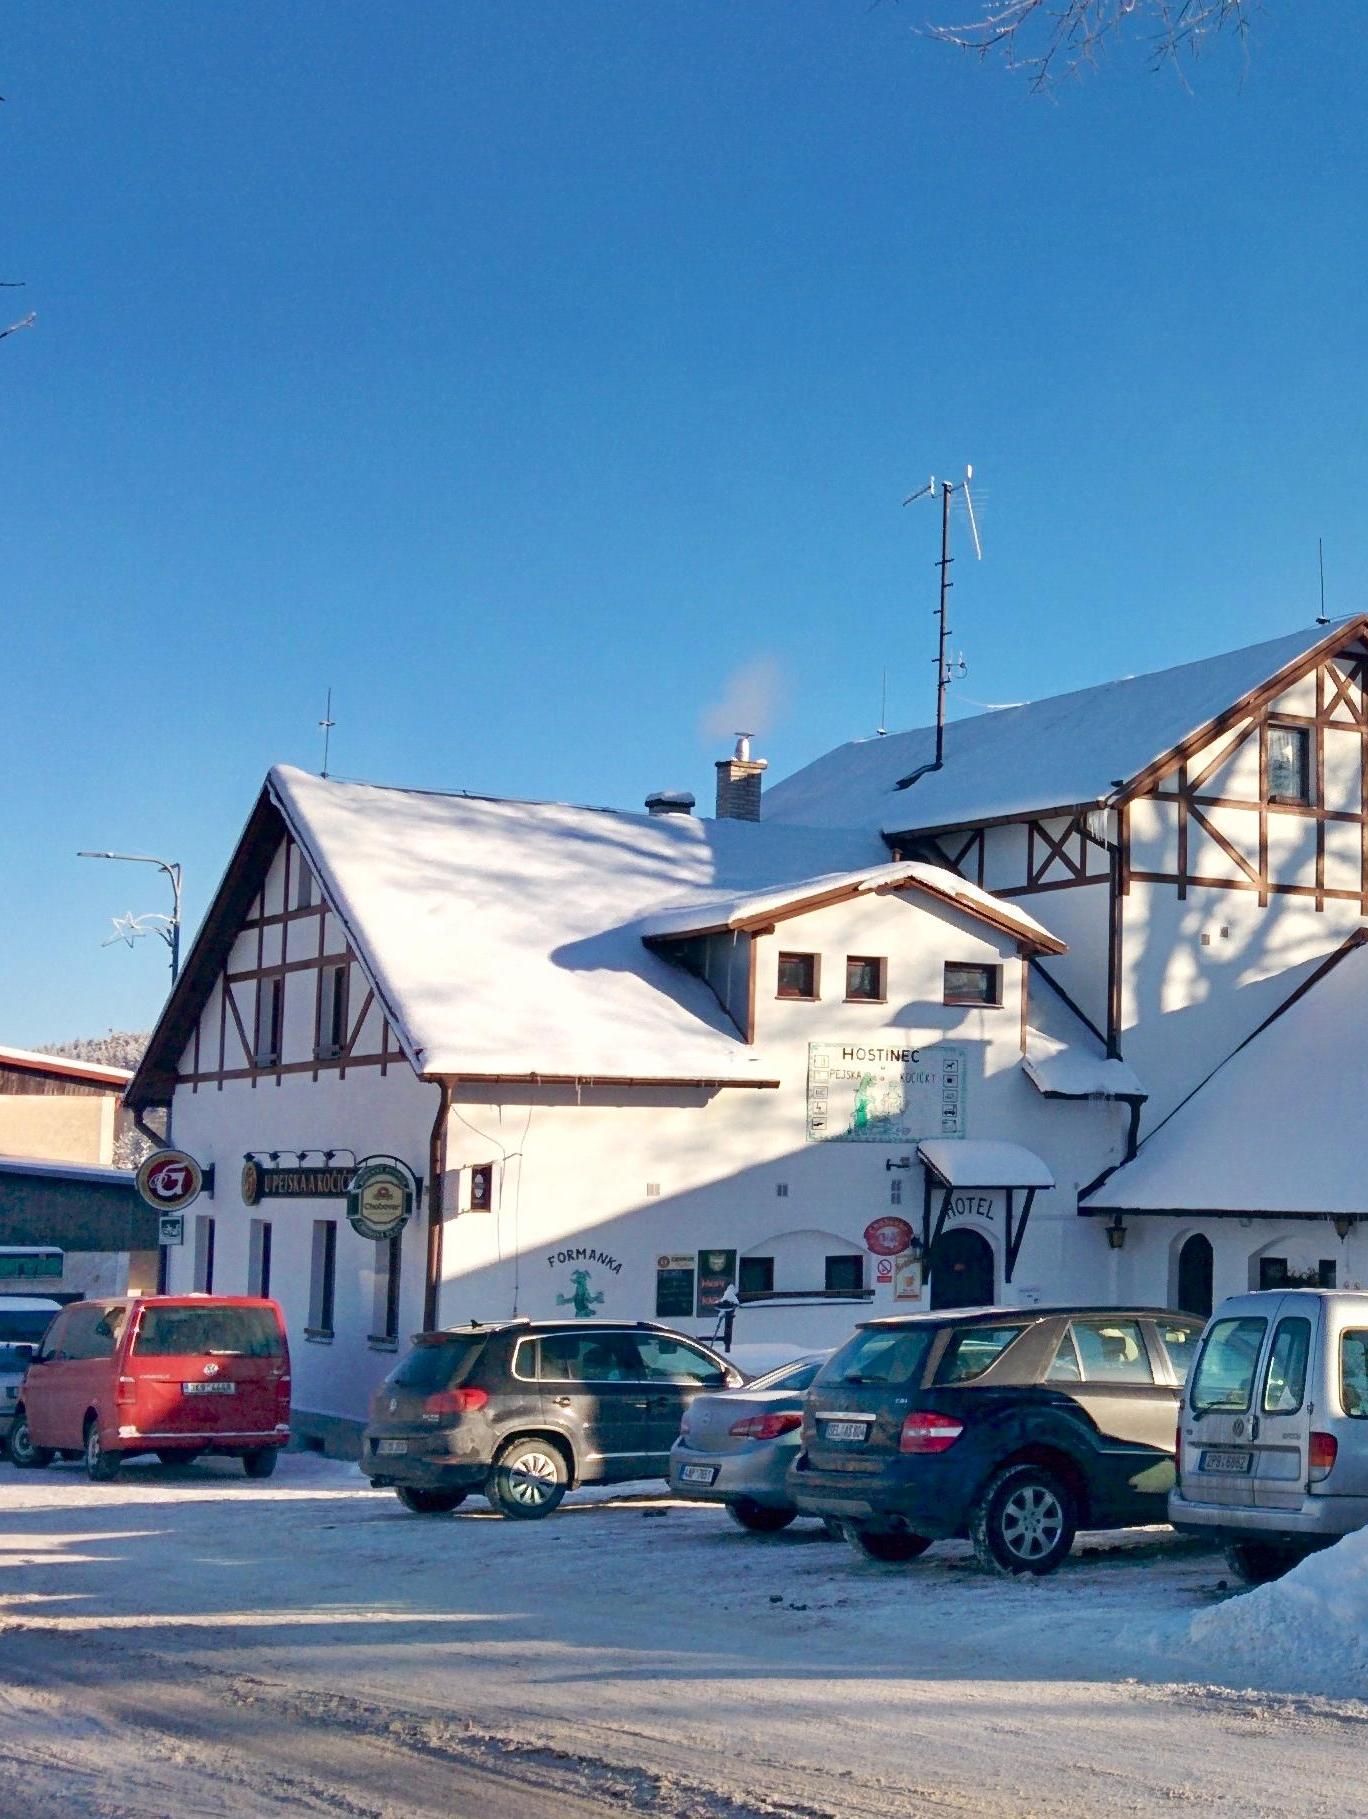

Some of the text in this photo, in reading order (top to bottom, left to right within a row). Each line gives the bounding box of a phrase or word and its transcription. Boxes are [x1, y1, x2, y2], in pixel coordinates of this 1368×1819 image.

[842, 1047, 920, 1063] HOSTINEC
[272, 1173, 307, 1193] PEJSKA
[308, 1174, 316, 1193] A
[547, 1248, 623, 1275] FORMANKA
